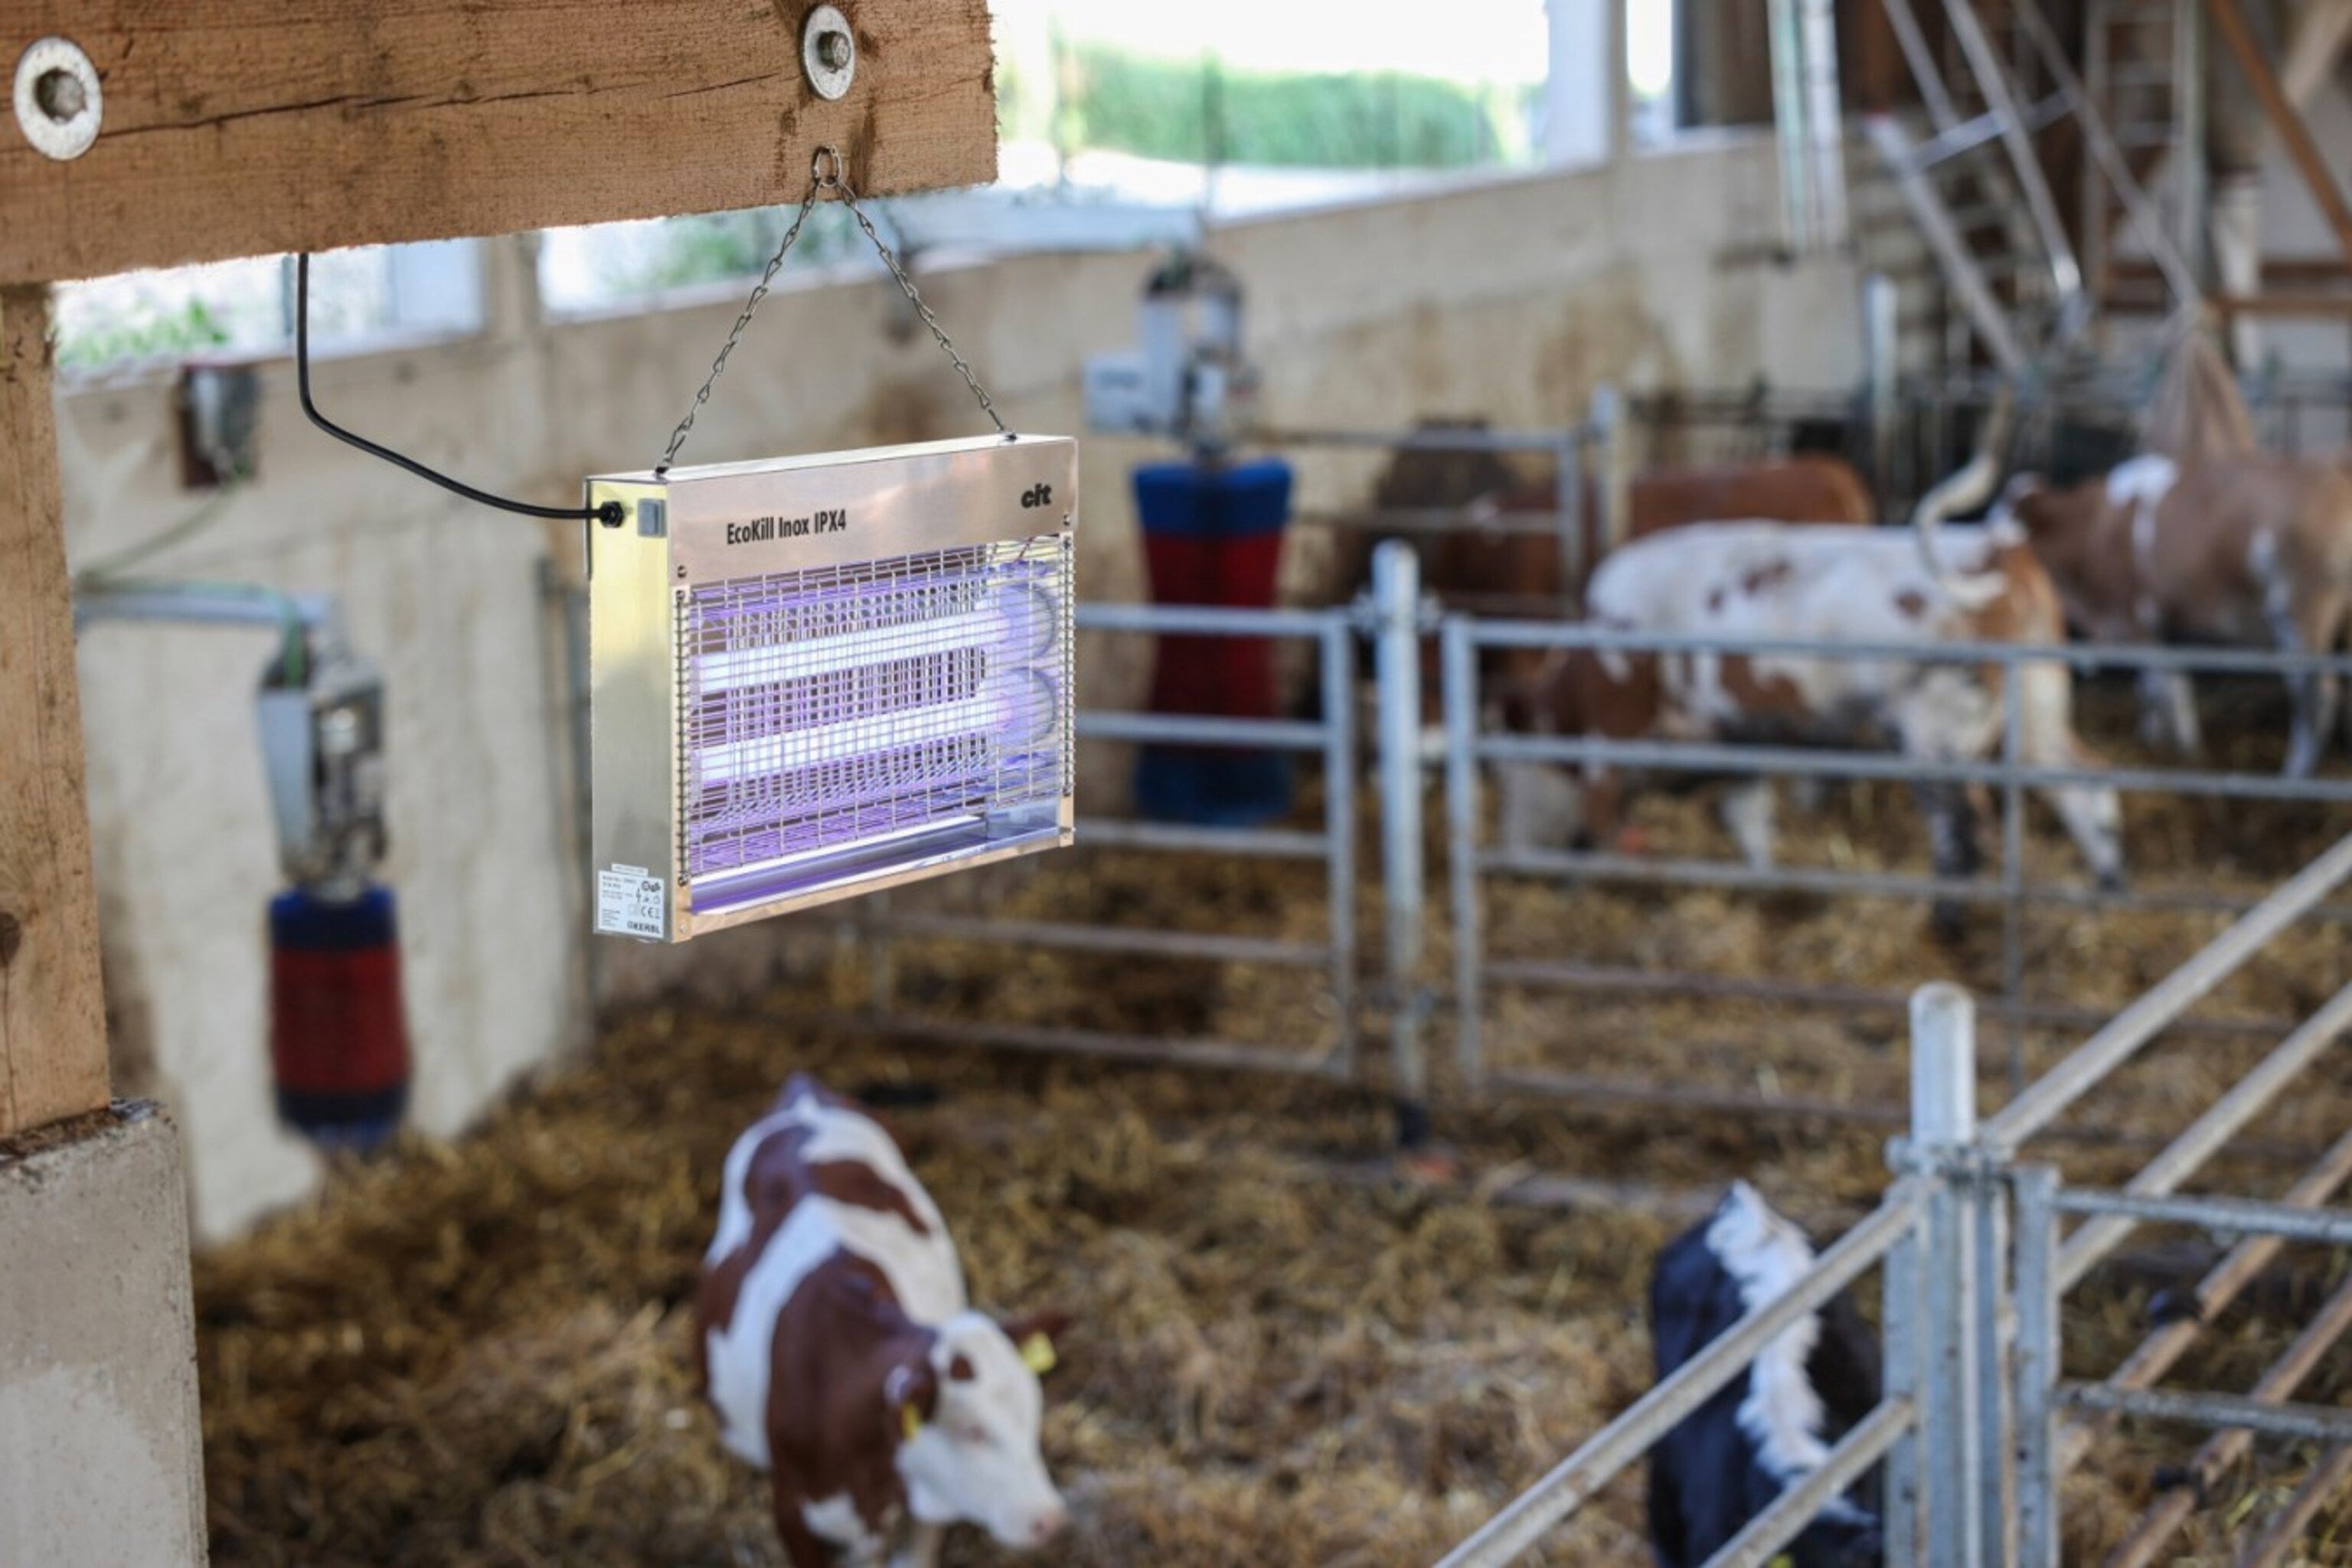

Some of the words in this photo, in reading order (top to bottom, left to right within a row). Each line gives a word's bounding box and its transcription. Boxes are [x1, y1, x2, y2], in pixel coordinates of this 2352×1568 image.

[727, 516, 775, 545] EcoKill
[779, 516, 810, 539] Inox
[814, 508, 847, 534] IPX4
